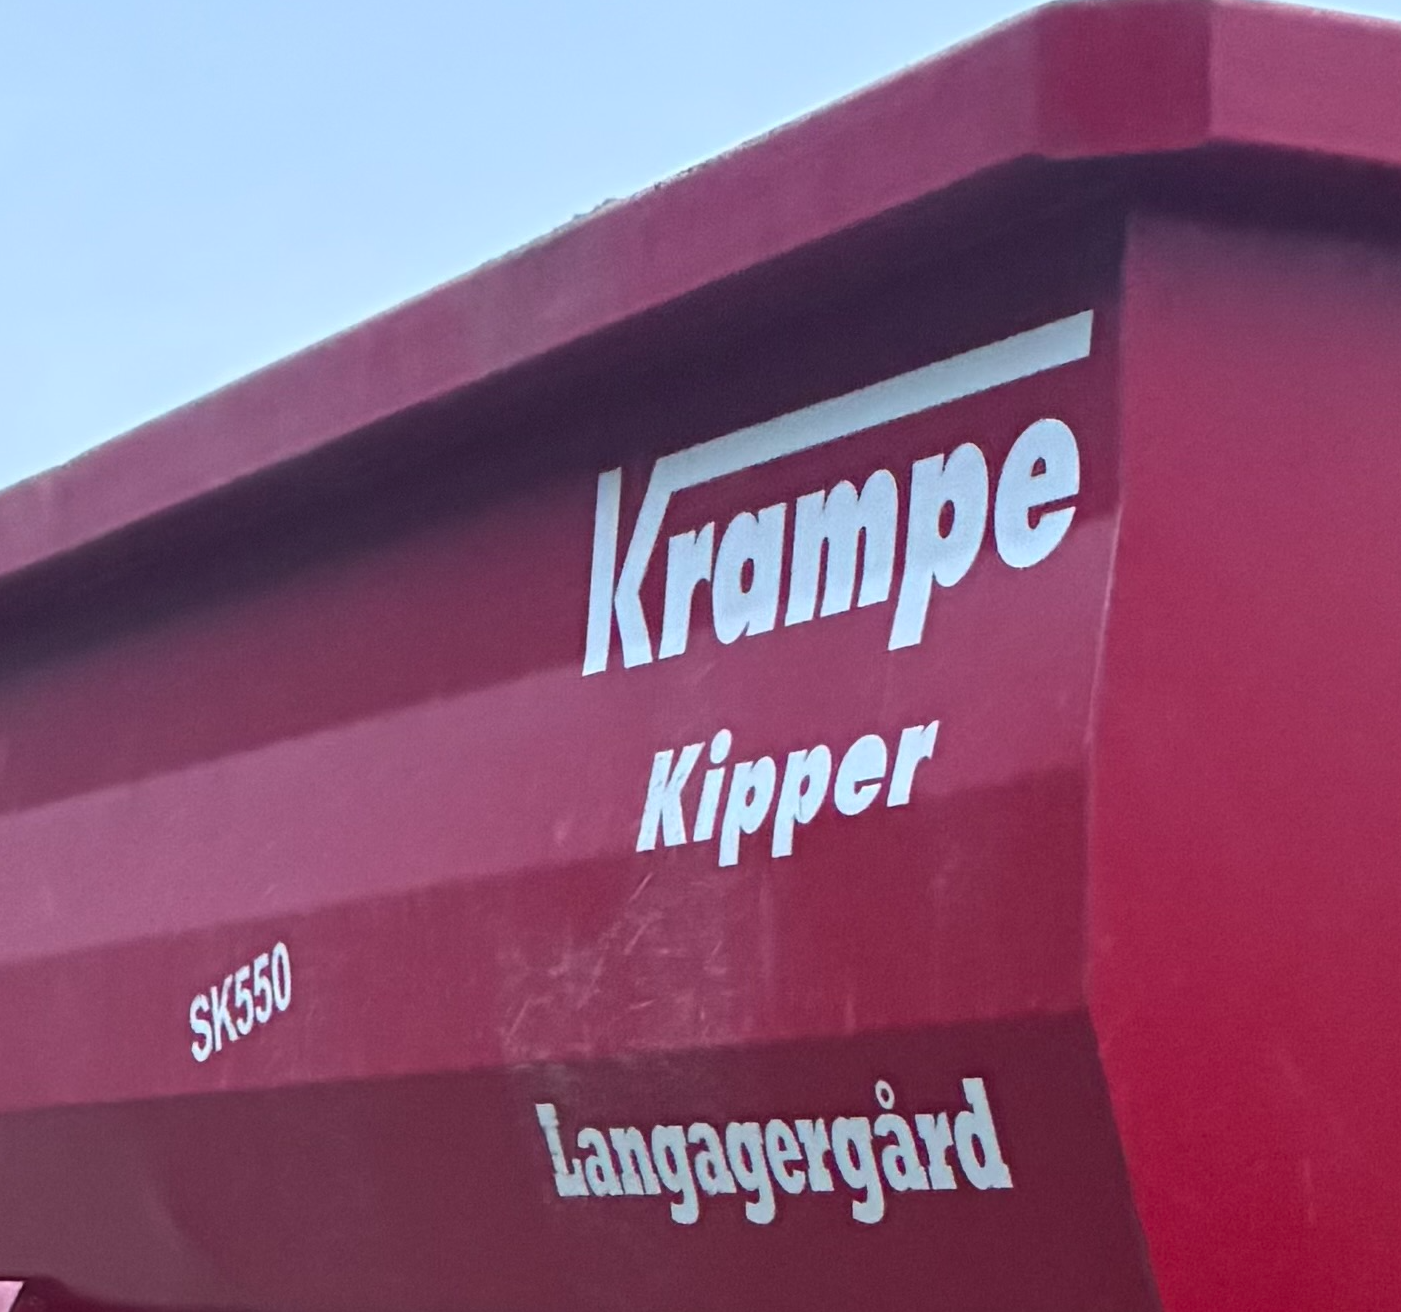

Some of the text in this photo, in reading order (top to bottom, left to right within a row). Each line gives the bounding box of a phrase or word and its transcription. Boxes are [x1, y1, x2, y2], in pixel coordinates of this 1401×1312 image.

[582, 309, 1094, 677] Krampe
[636, 719, 940, 867] Kipper
[189, 941, 292, 1063] SK550
[535, 1077, 1013, 1225] Langagergård
